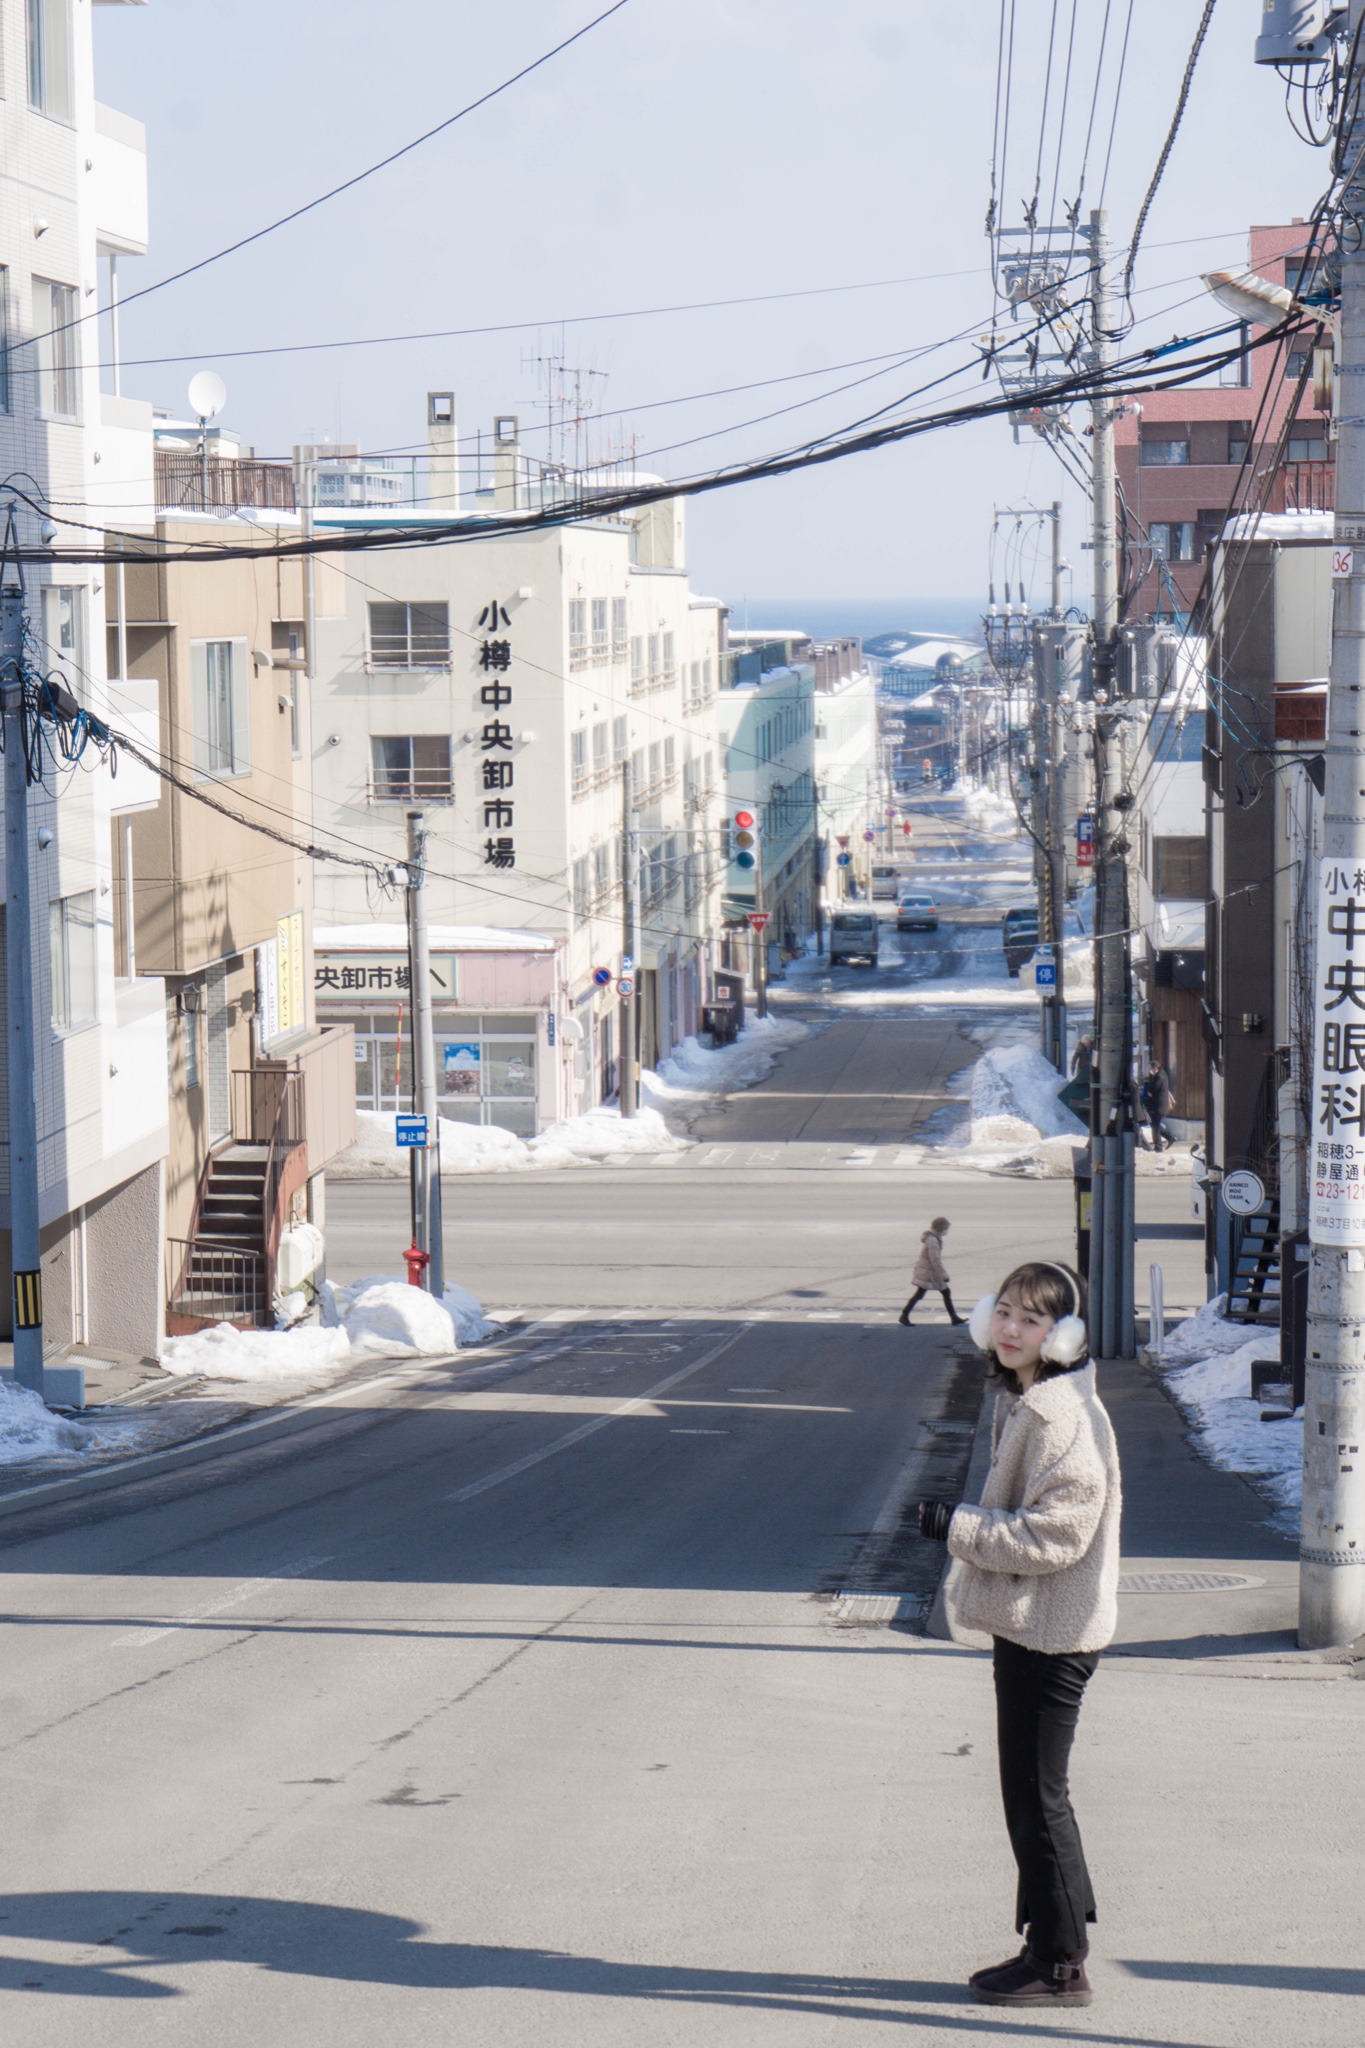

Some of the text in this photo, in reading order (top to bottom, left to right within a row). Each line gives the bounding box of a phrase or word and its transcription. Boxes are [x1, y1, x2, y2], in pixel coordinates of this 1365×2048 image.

[478, 600, 516, 869] 小樽中央卸市場
[620, 983, 633, 993] 30
[1320, 897, 1365, 1137] 中央眼科
[398, 1132, 426, 1142] 停止線
[1316, 1161, 1365, 1181] 静屋通
